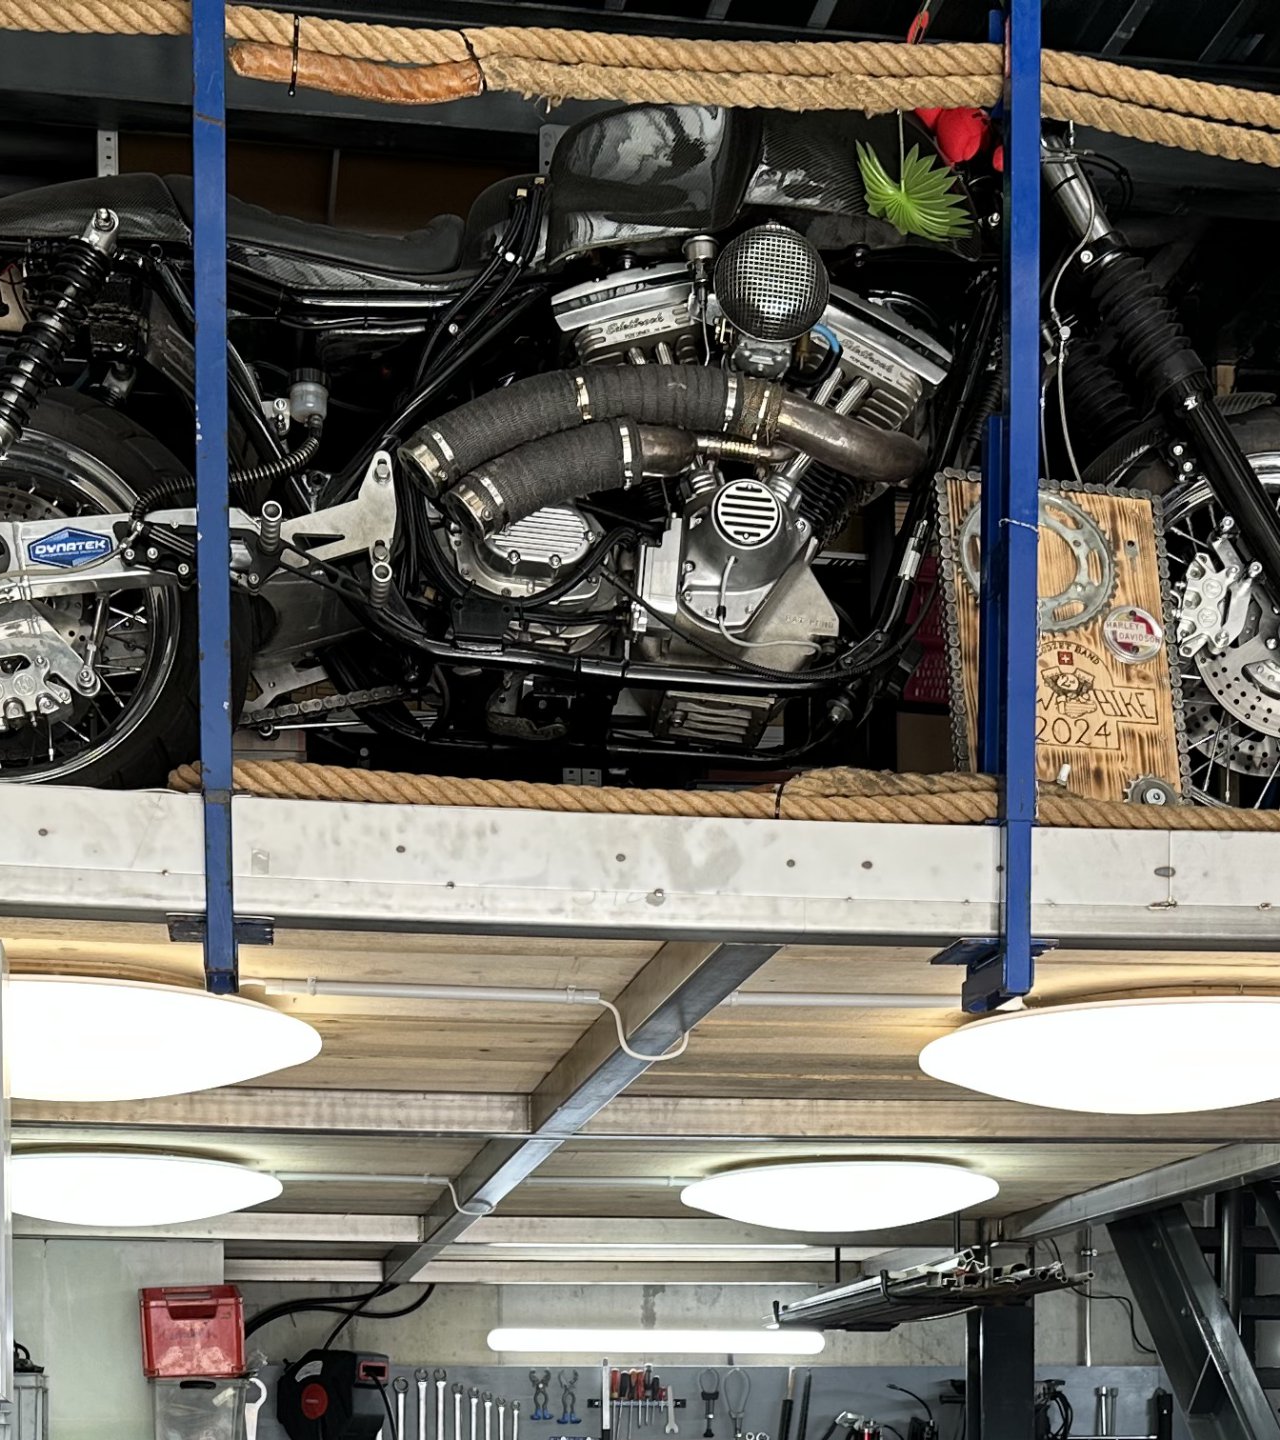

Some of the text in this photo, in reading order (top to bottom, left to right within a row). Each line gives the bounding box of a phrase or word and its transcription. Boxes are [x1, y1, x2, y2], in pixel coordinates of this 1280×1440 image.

[34, 540, 107, 555] DYNATEK
[1074, 645, 1100, 665] BAND
[1094, 689, 1156, 719] BIKE
[1036, 716, 1111, 747] 2024
